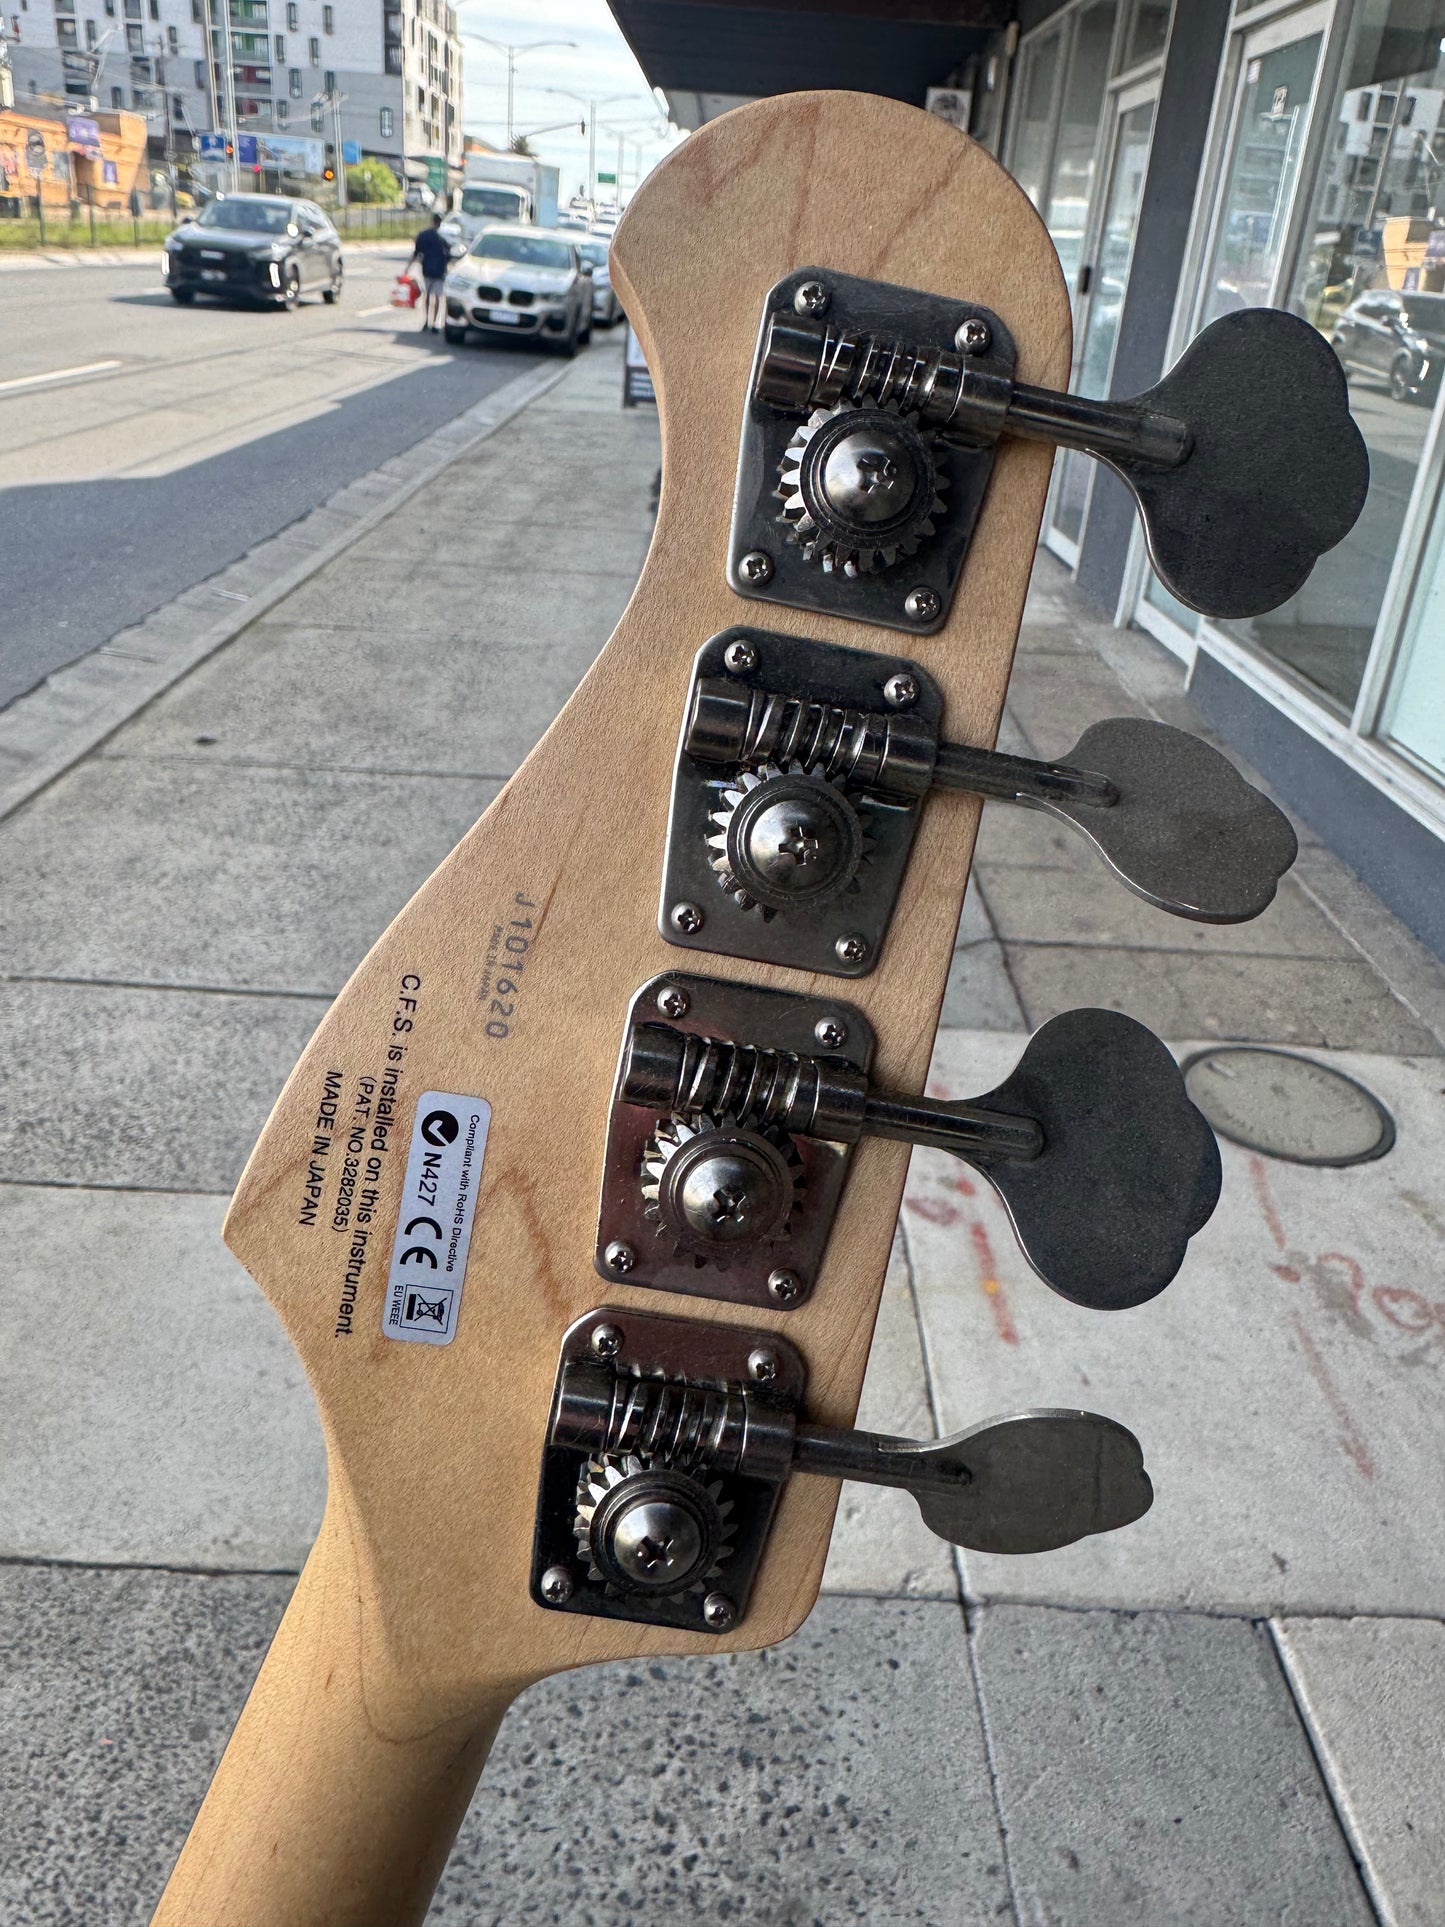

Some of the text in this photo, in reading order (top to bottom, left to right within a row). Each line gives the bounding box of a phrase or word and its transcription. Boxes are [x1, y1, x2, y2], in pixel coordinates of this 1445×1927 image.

[485, 891, 535, 1039] J101620
[299, 1071, 343, 1226] MADE IN JAPAN
[331, 1076, 377, 1233] (PAT. NO.3282035)
[335, 974, 420, 1338] C.F.S. is installed on this instrument.
[417, 1152, 442, 1207] N427
[446, 1114, 480, 1272] Compliant with RoHS Directive
[389, 1285, 404, 1326] EU WEEE
[400, 1216, 443, 1270] CE
